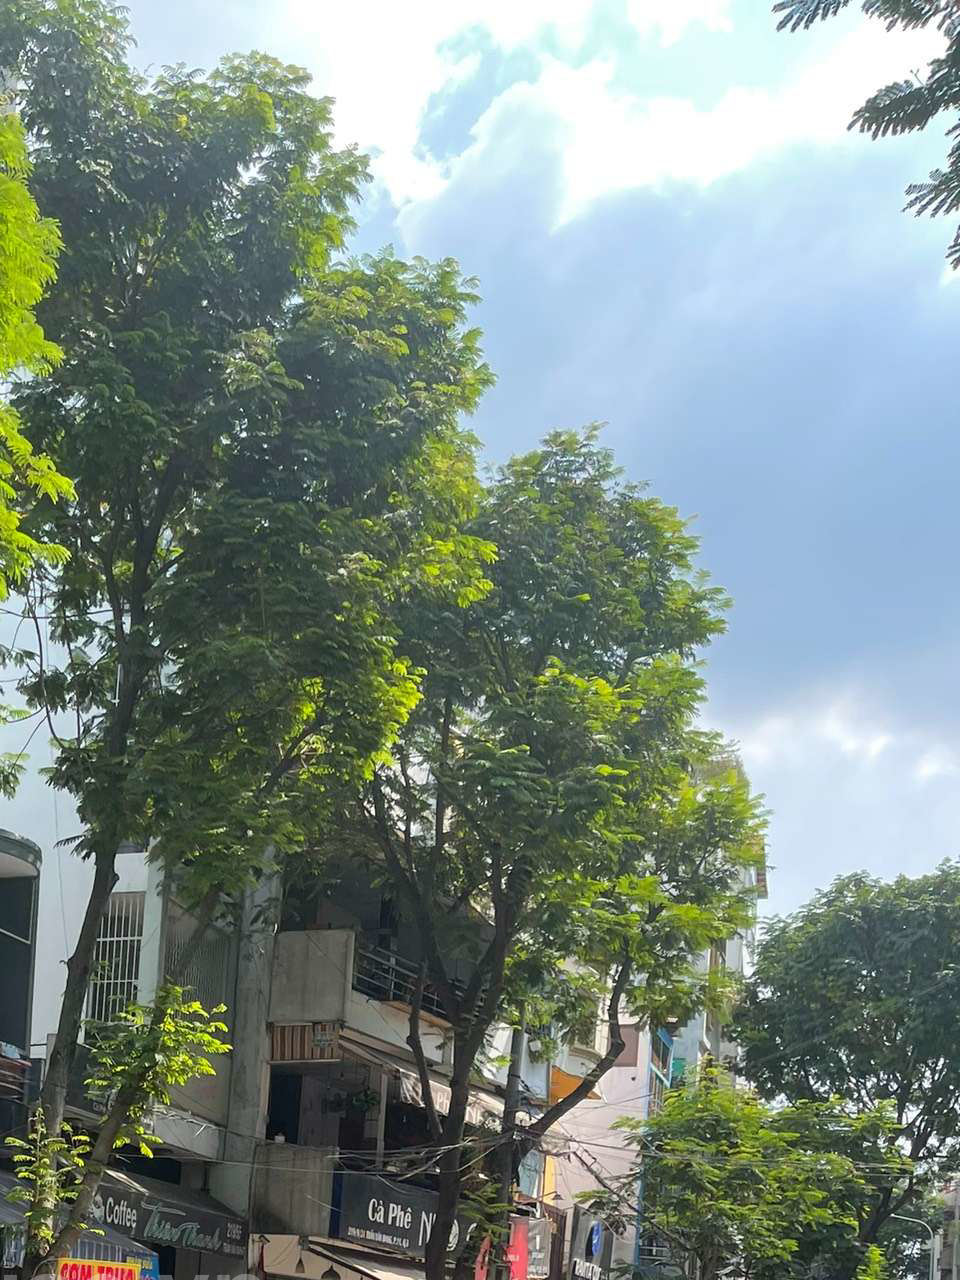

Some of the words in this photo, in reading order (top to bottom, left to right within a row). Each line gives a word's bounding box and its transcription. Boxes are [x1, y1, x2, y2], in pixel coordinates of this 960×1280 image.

[105, 1196, 138, 1229] Coffee
[368, 1198, 385, 1224] Cà
[388, 1203, 412, 1230] Phê
